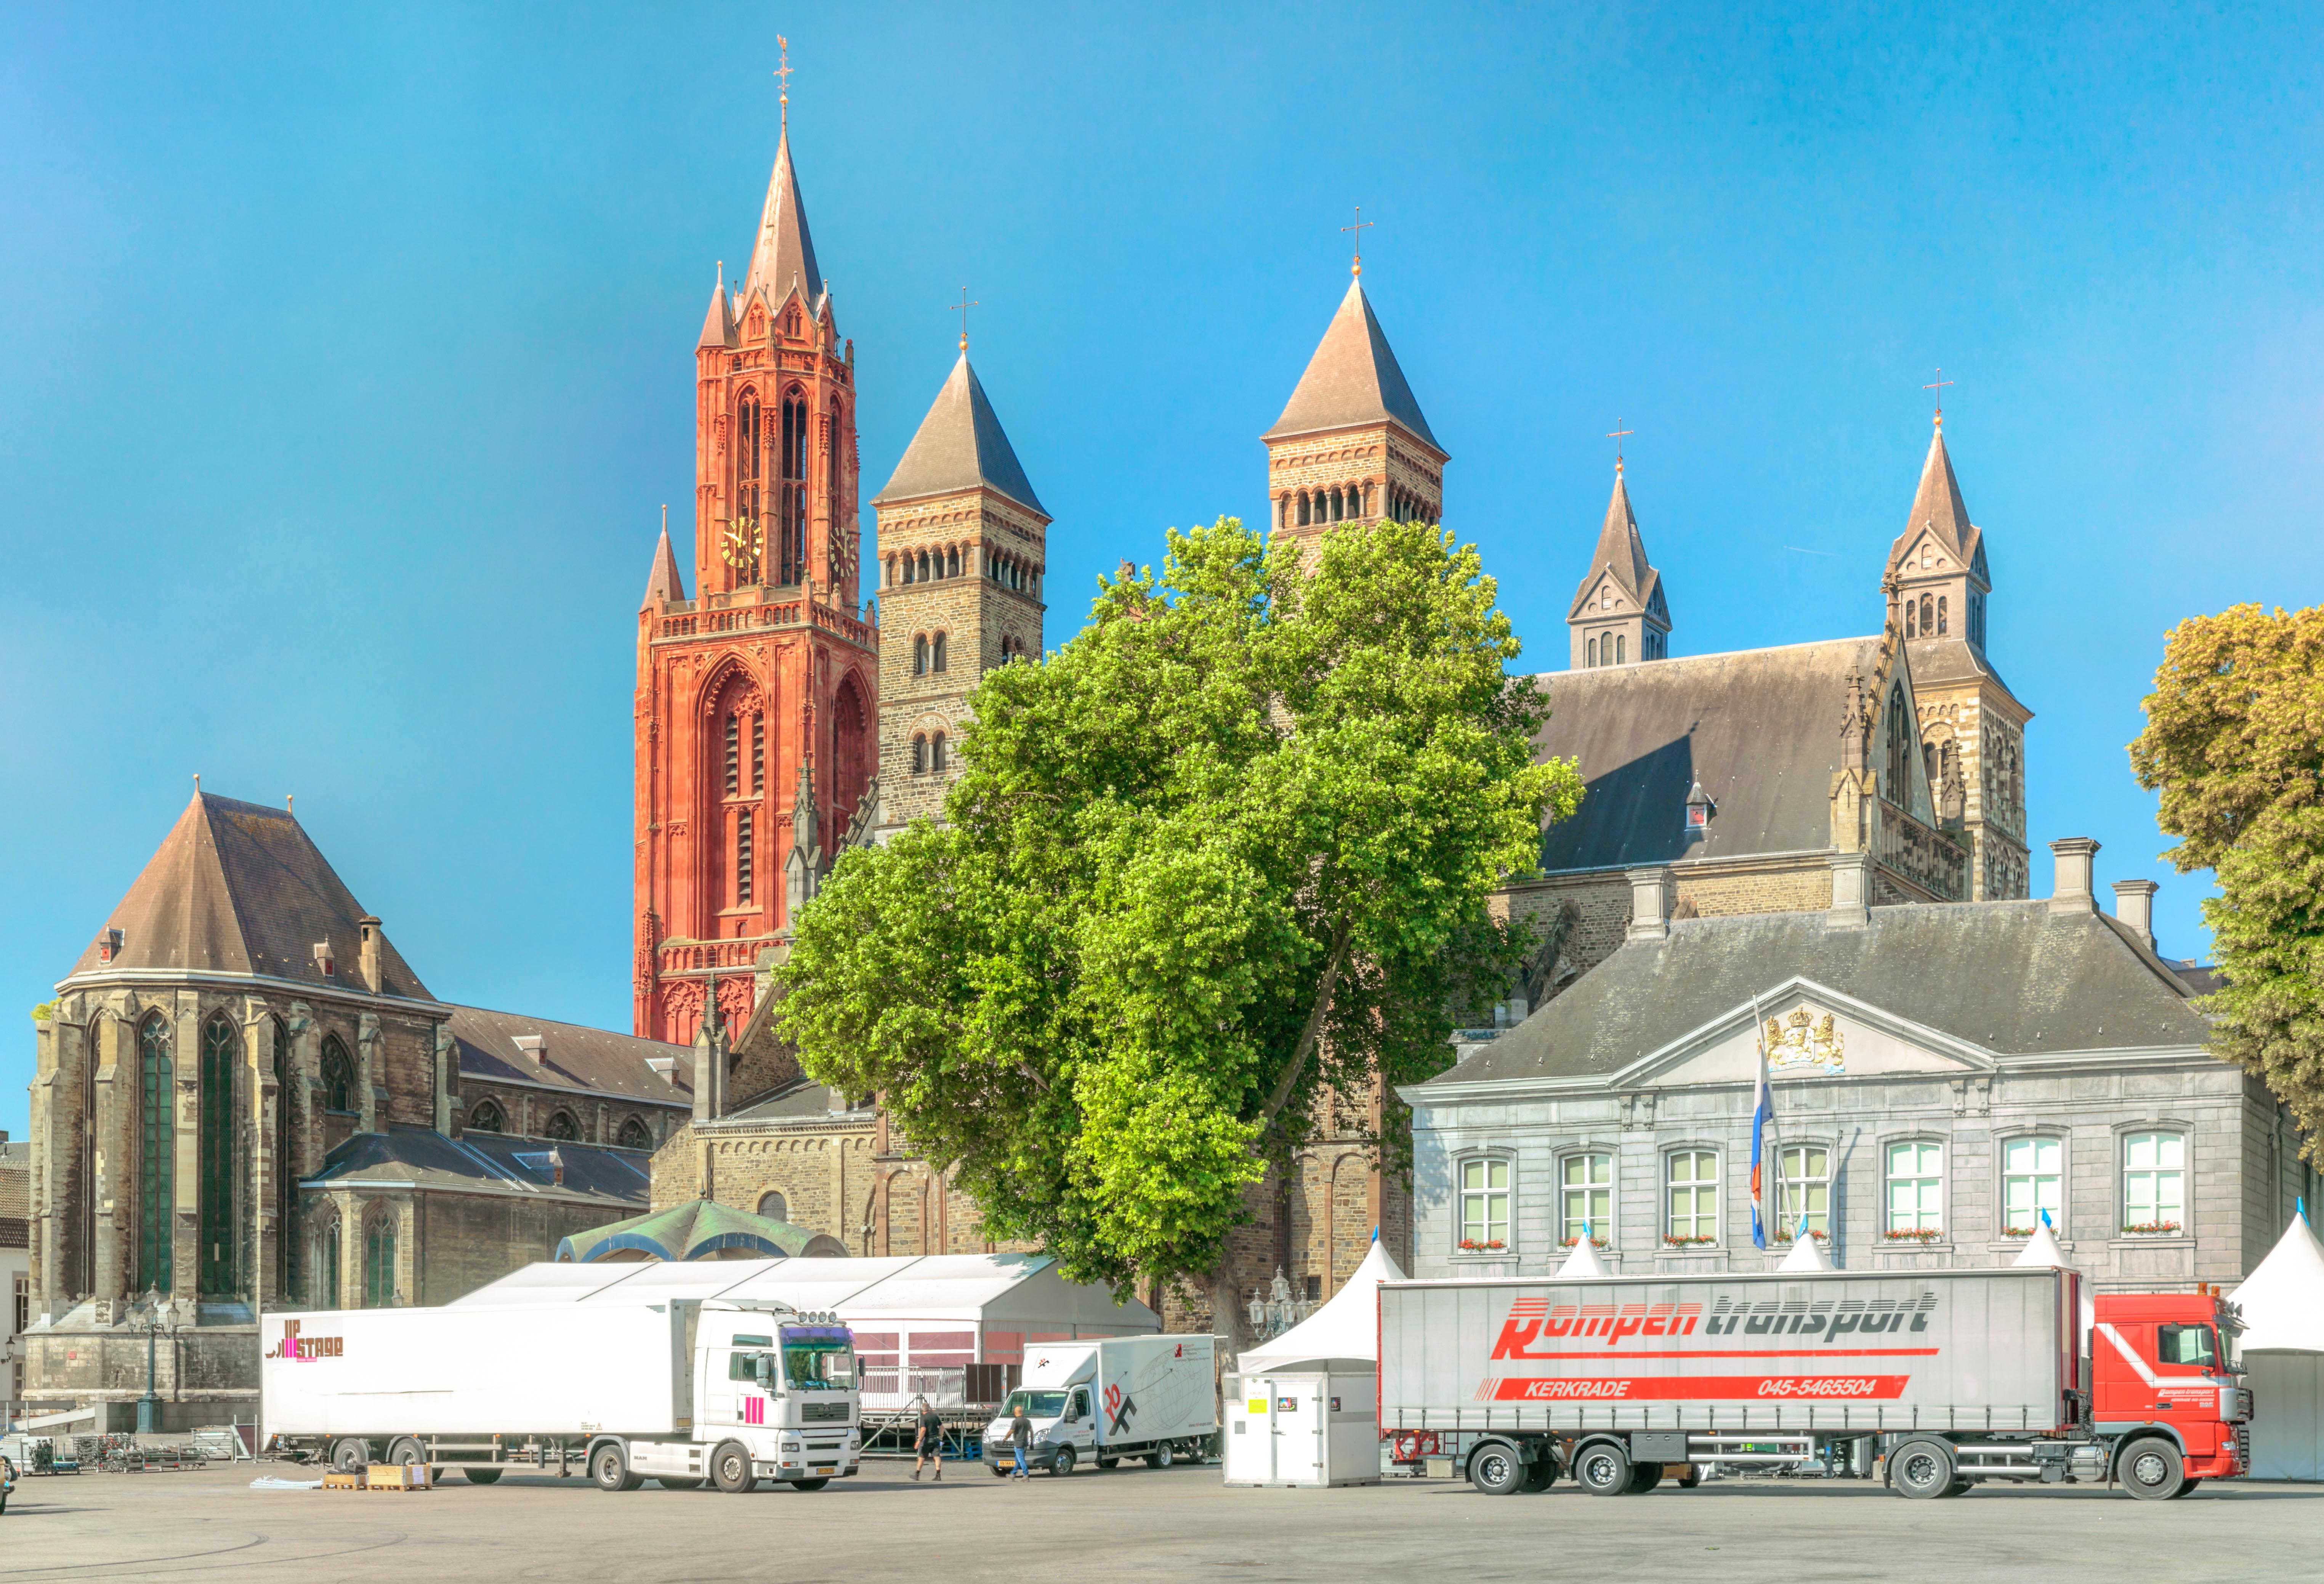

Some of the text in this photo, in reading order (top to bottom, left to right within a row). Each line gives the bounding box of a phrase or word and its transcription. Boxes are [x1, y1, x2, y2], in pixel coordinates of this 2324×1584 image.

[1490, 1292, 1938, 1360] Rompen transport
[1524, 1379, 1877, 1397] KERKRADE 045-5465504
[2157, 1389, 2185, 1397] Rompen
